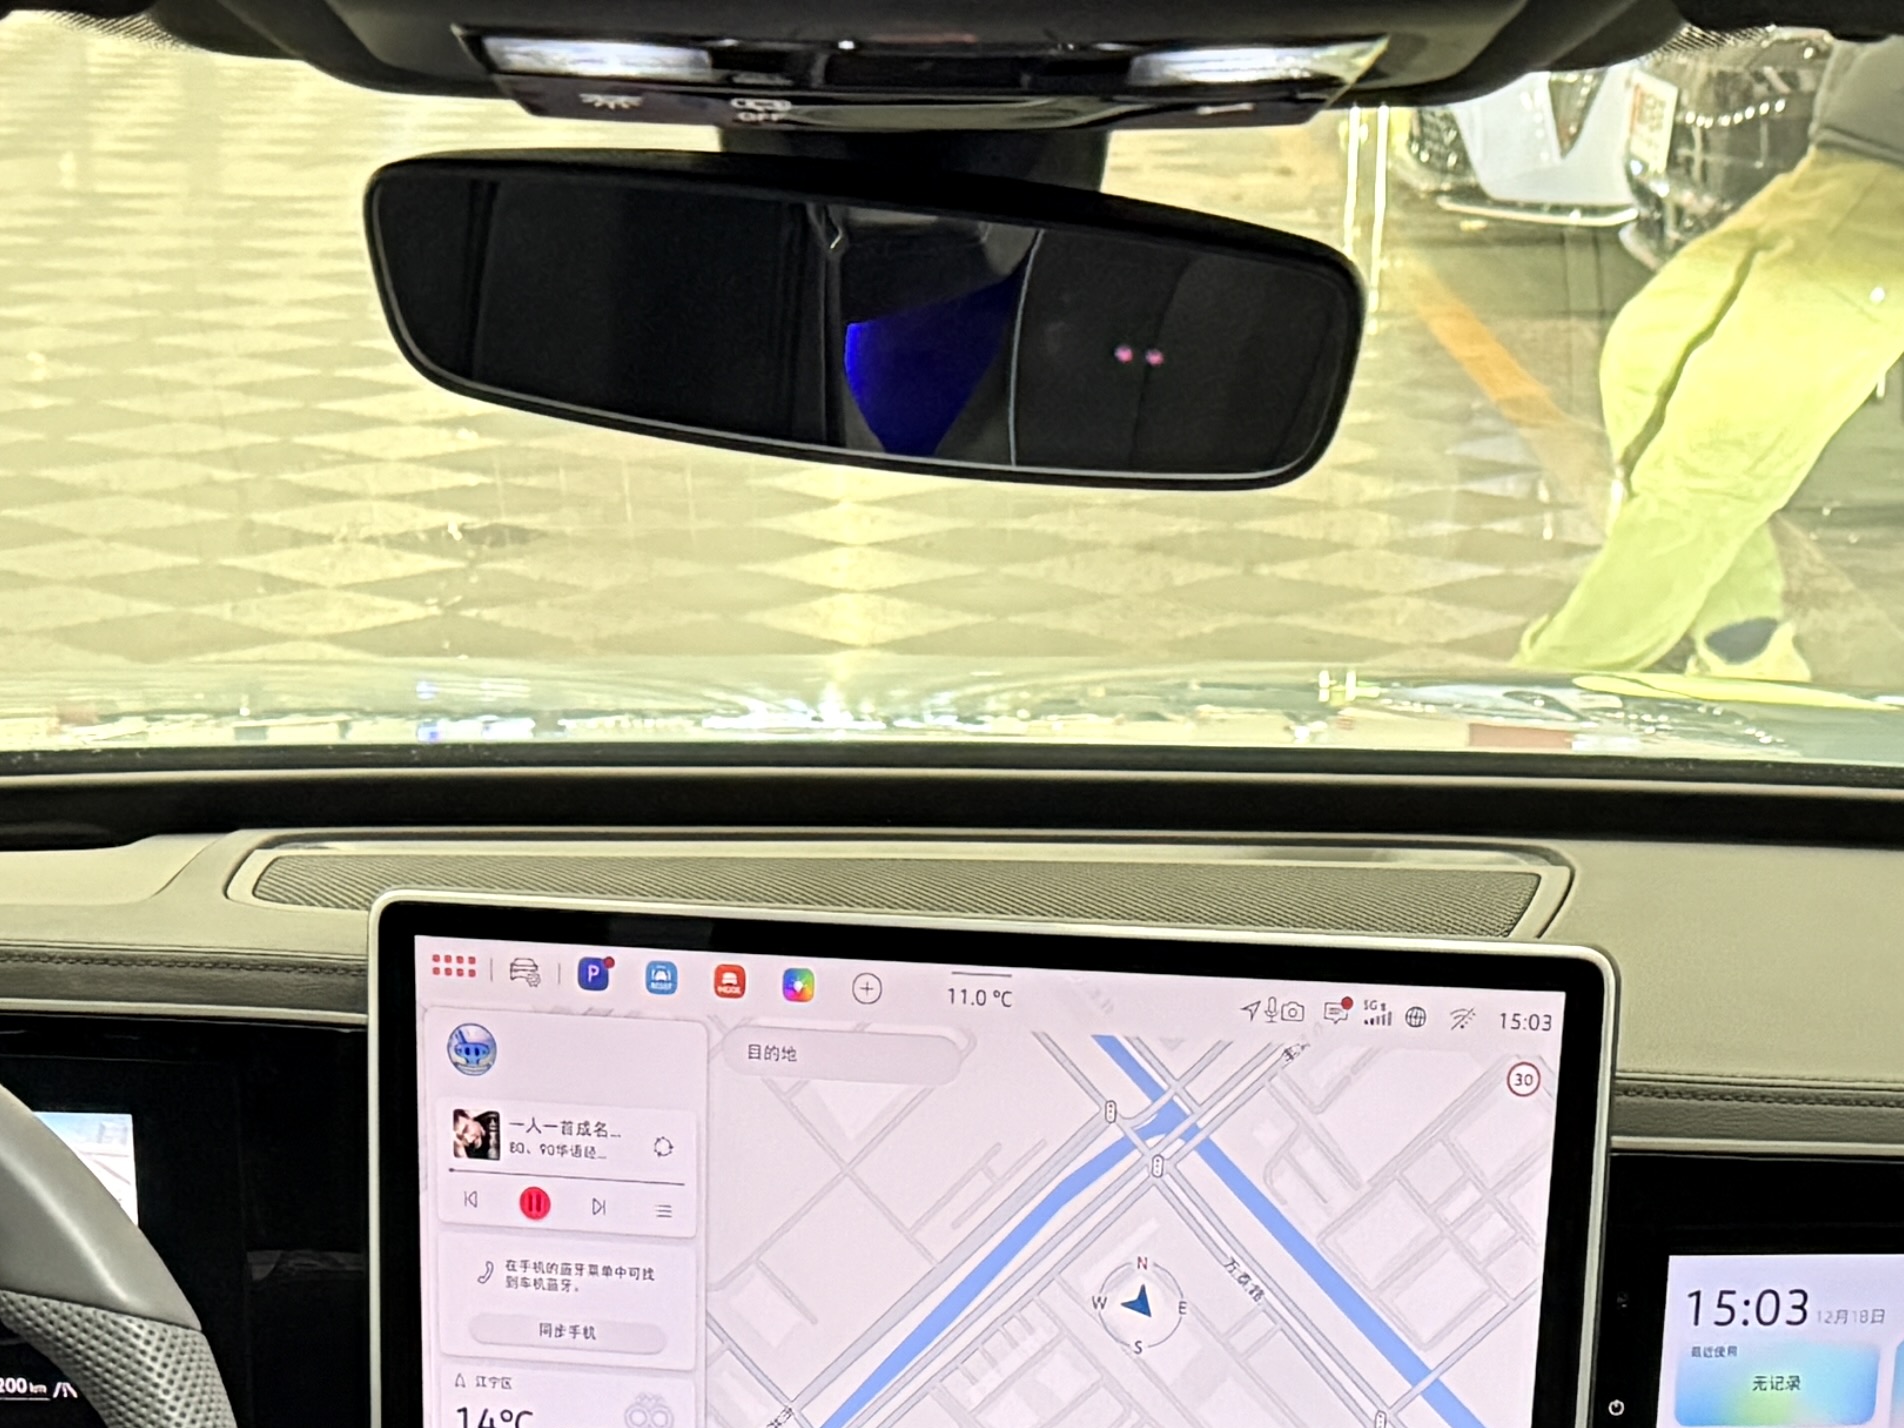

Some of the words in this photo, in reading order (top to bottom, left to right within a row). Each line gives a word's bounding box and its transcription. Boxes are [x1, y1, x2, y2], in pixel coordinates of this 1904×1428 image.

[947, 987, 987, 1007] 11.0
[1499, 1011, 1554, 1032] 15:03
[747, 1043, 798, 1063] 目的地
[1513, 1072, 1534, 1087] 30
[1137, 1256, 1148, 1270] N
[1092, 1296, 1108, 1309] W
[1178, 1301, 1187, 1315] E
[1687, 1288, 1809, 1326] 15:03
[1816, 1308, 1886, 1324] 12月18日
[539, 1322, 597, 1341] 同步手机
[1134, 1340, 1143, 1354] S
[1752, 1375, 1801, 1391] 无记录
